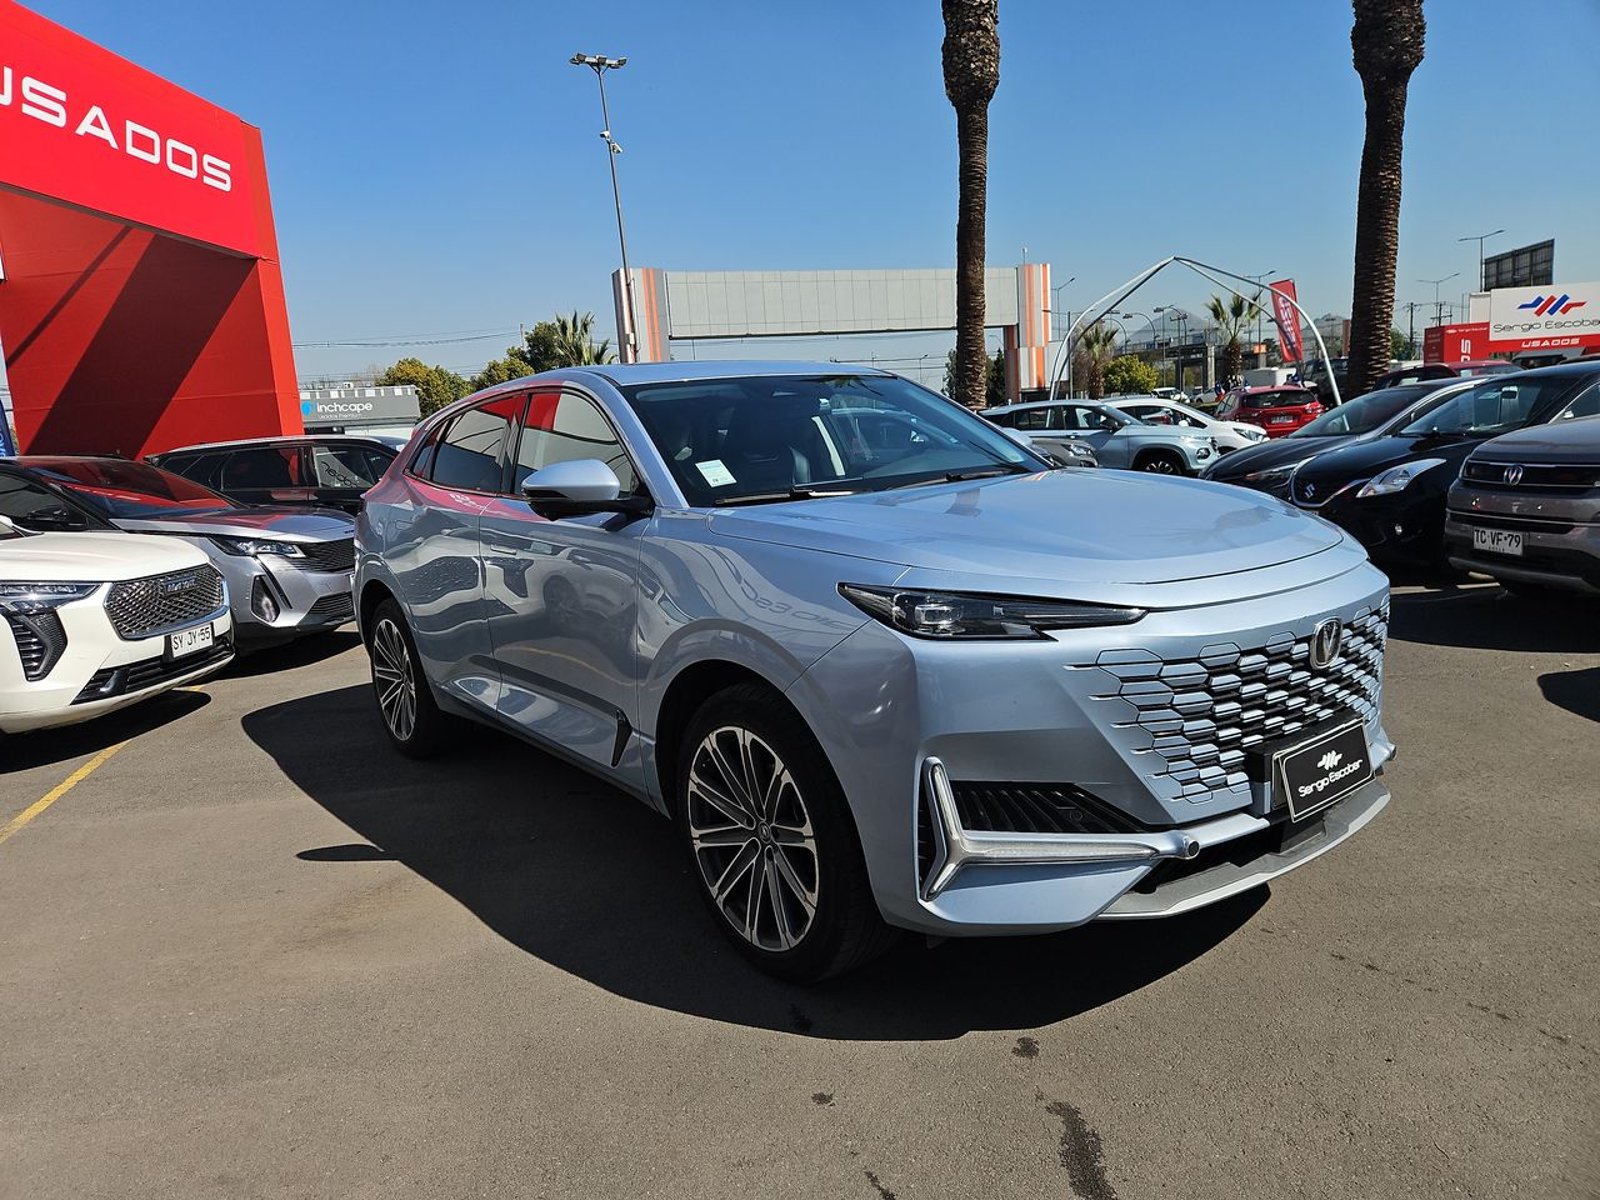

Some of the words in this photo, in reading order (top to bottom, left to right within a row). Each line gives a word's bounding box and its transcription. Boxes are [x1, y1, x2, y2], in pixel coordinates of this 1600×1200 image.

[0, 65, 232, 192] SADOS
[1544, 318, 1600, 330] Escoba
[1521, 338, 1581, 348] USADOS
[1328, 759, 1363, 783] Escobar
